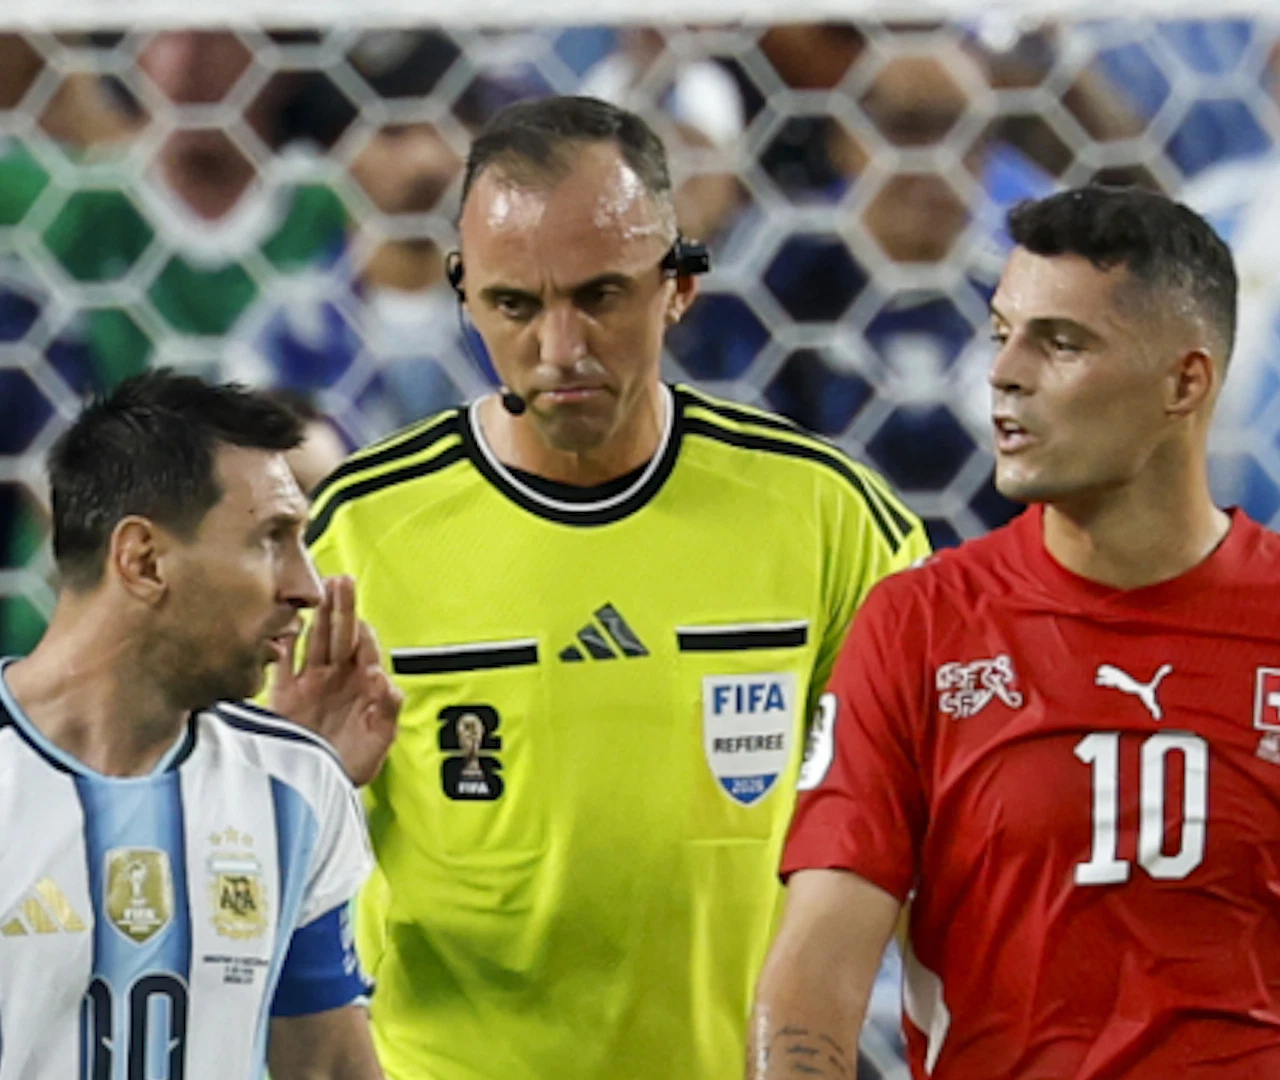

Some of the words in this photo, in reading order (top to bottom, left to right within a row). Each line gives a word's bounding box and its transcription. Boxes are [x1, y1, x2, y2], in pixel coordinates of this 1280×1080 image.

[713, 682, 785, 715] FIFA
[714, 734, 784, 753] REFEREE
[458, 781, 489, 794] FIFA
[1073, 729, 1208, 887] 10
